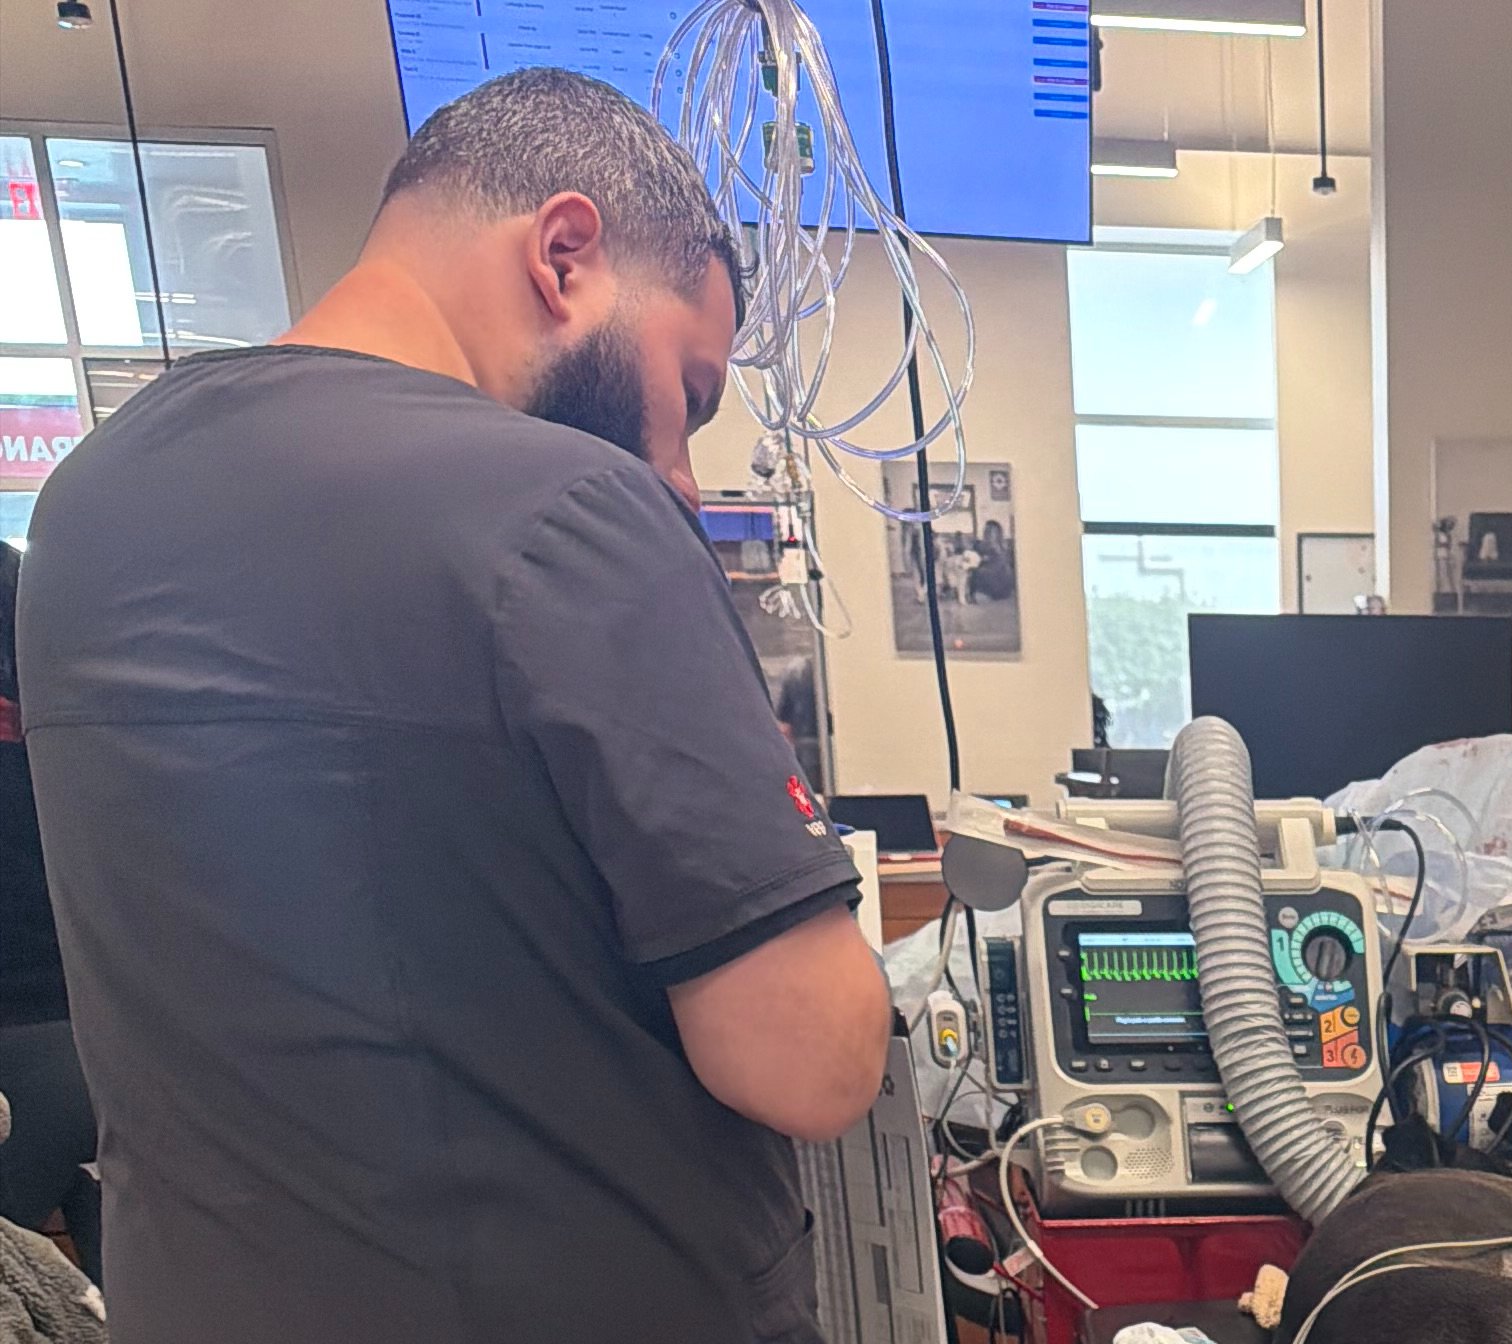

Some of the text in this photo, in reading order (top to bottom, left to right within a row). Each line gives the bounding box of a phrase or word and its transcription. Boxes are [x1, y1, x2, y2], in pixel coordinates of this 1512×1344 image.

[1277, 936, 1285, 952] 1
[1324, 1020, 1332, 1034] 2
[1326, 1050, 1335, 1062] 3
